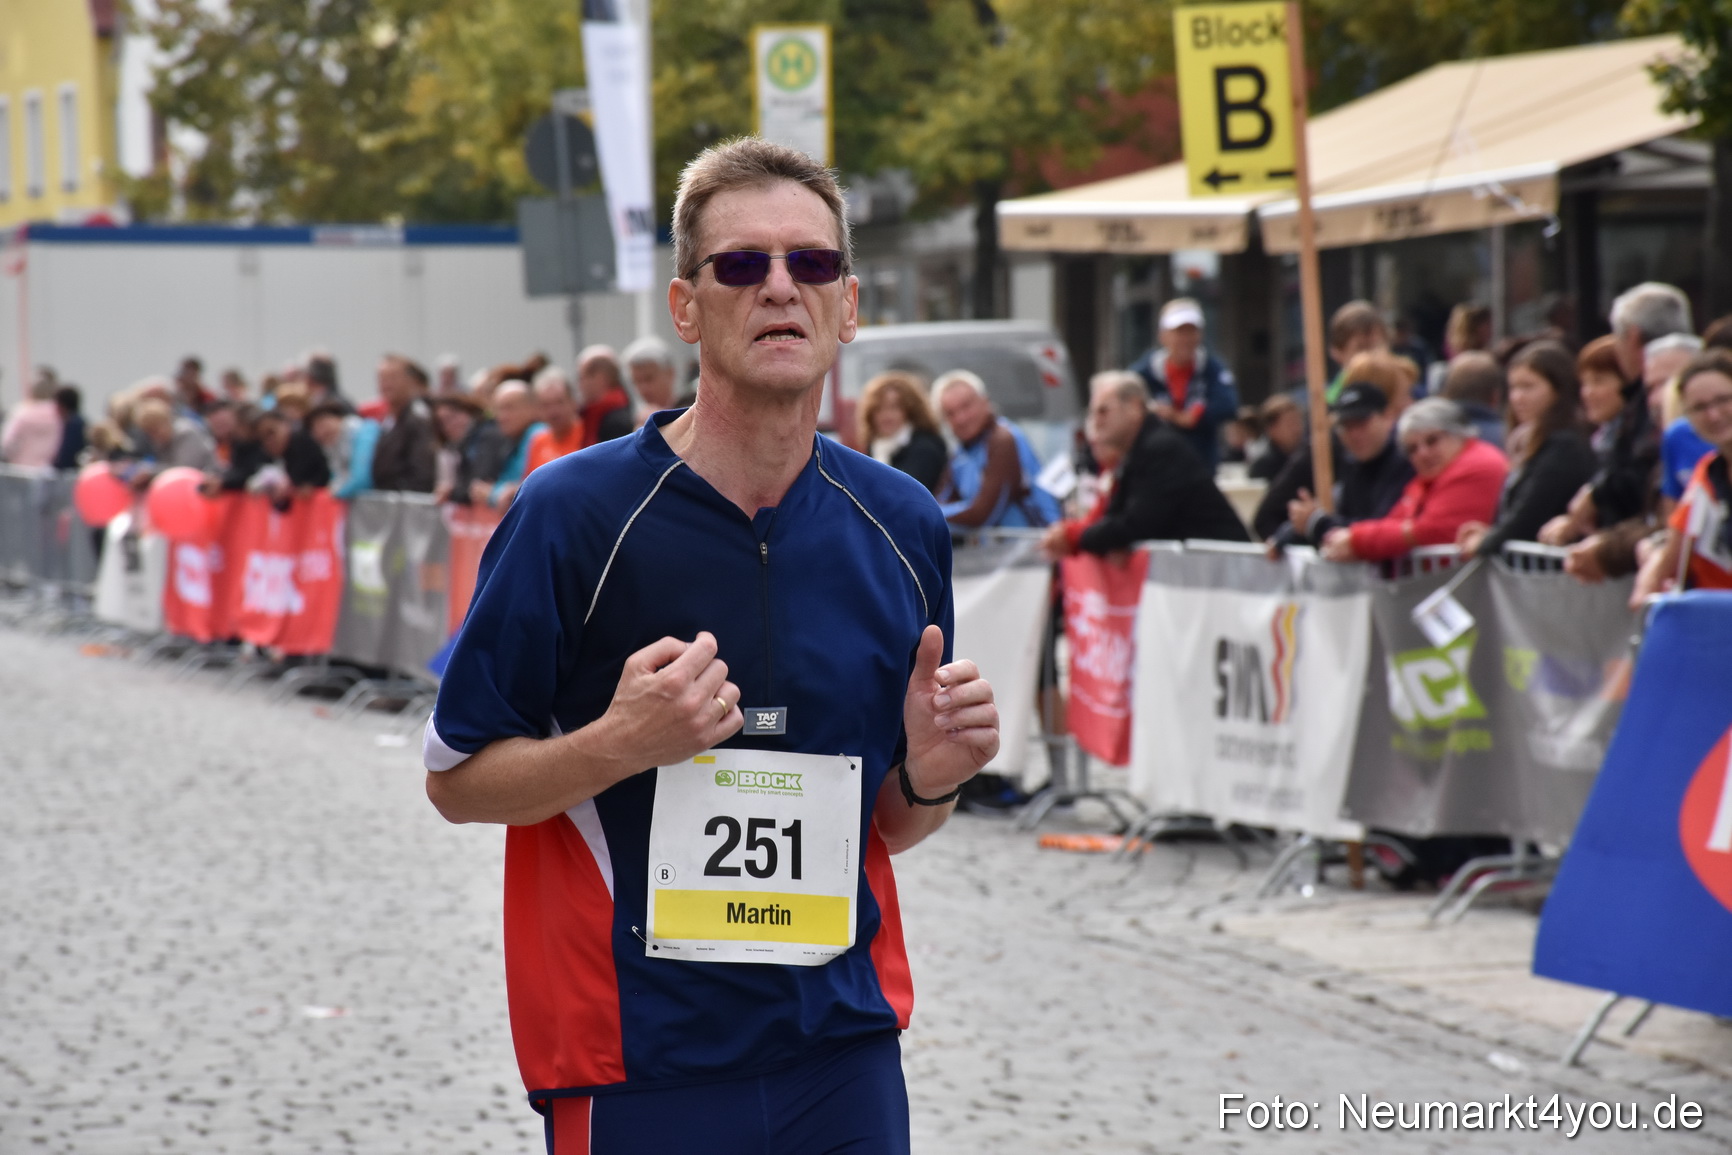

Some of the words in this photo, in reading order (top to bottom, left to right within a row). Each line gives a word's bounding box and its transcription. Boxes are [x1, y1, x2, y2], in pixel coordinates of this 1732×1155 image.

[1191, 13, 1286, 49] Block
[1213, 64, 1275, 154] B
[737, 770, 803, 791] BOCK
[703, 815, 802, 880] 251
[661, 868, 669, 880] B
[726, 902, 791, 926] Martin
